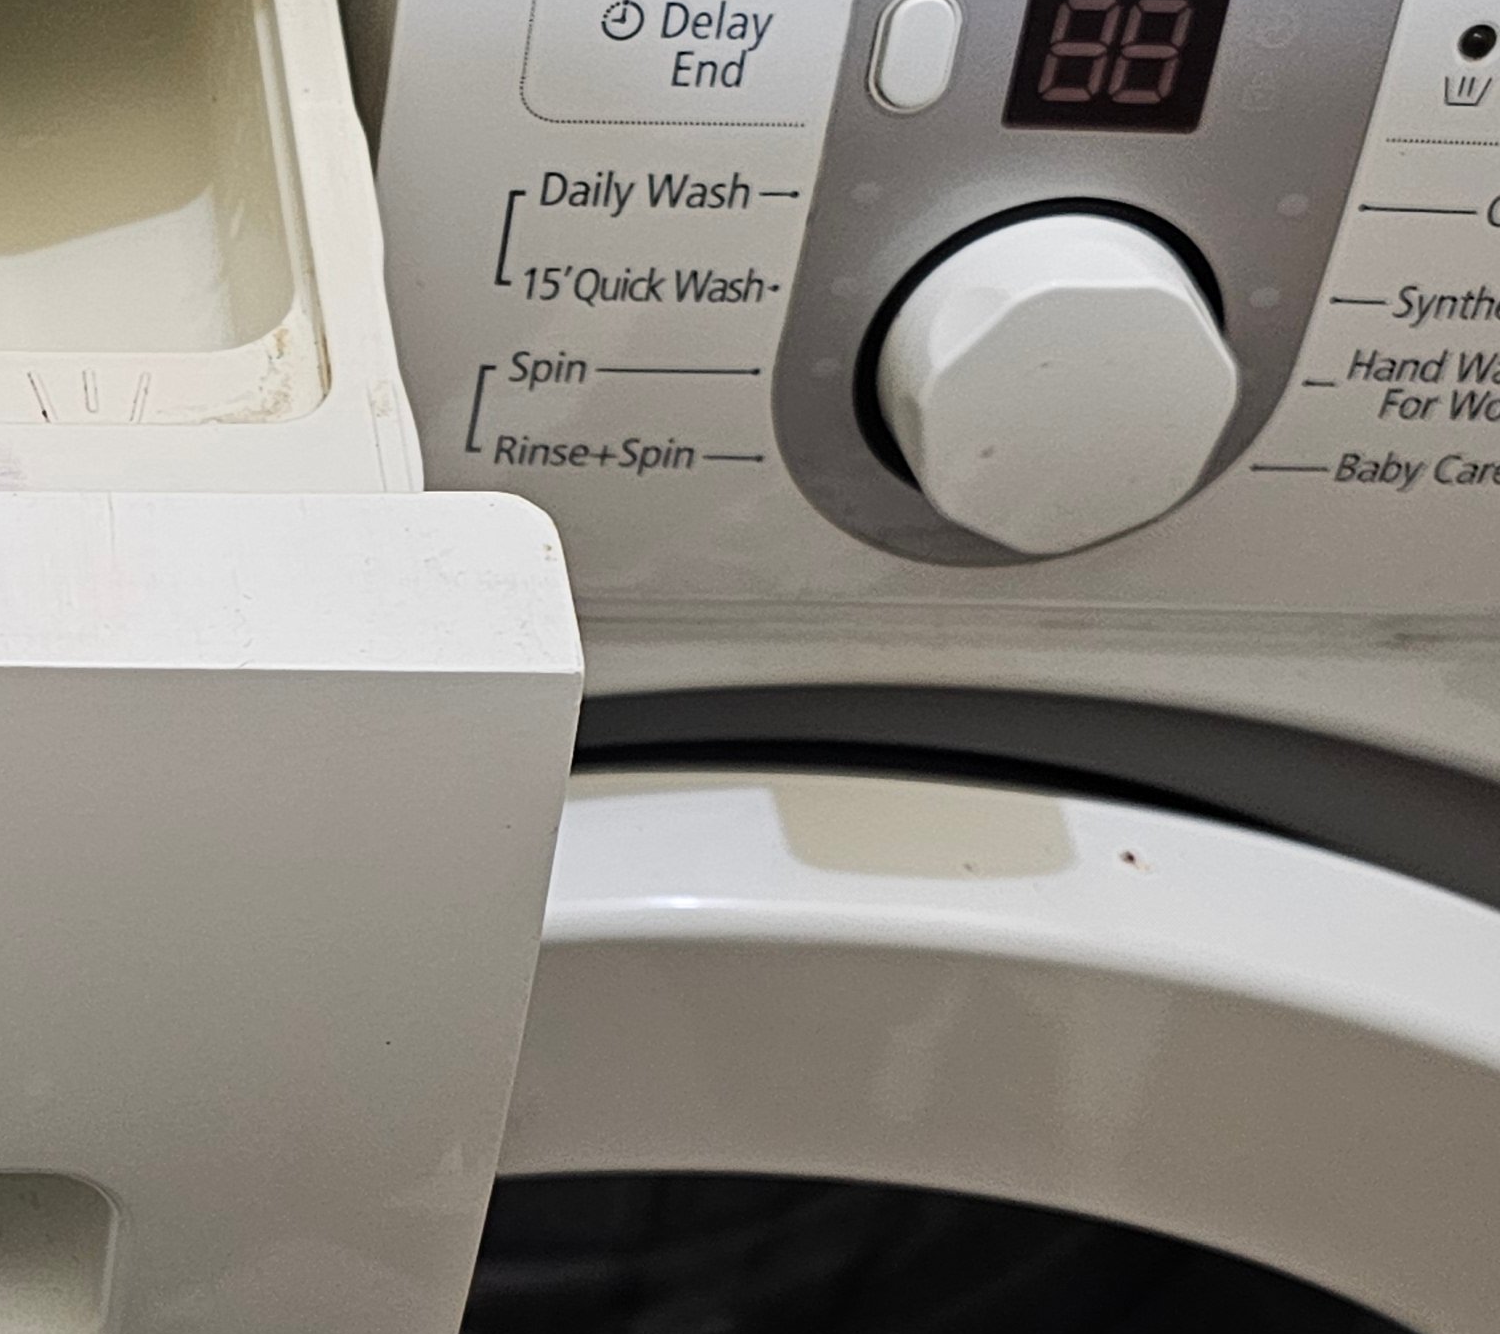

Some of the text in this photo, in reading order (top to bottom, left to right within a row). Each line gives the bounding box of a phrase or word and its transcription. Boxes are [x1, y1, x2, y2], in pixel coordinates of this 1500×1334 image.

[660, 0, 774, 52] Delay
[671, 51, 747, 88] End
[539, 170, 750, 218] Daily Wash
[675, 268, 764, 303] Wash
[1392, 284, 1500, 328] Synth
[508, 350, 587, 391] Spin
[1347, 349, 1449, 384] Hand
[1378, 387, 1440, 421] For
[493, 434, 695, 475] Rinse+Spin
[1334, 451, 1426, 493] Baby
